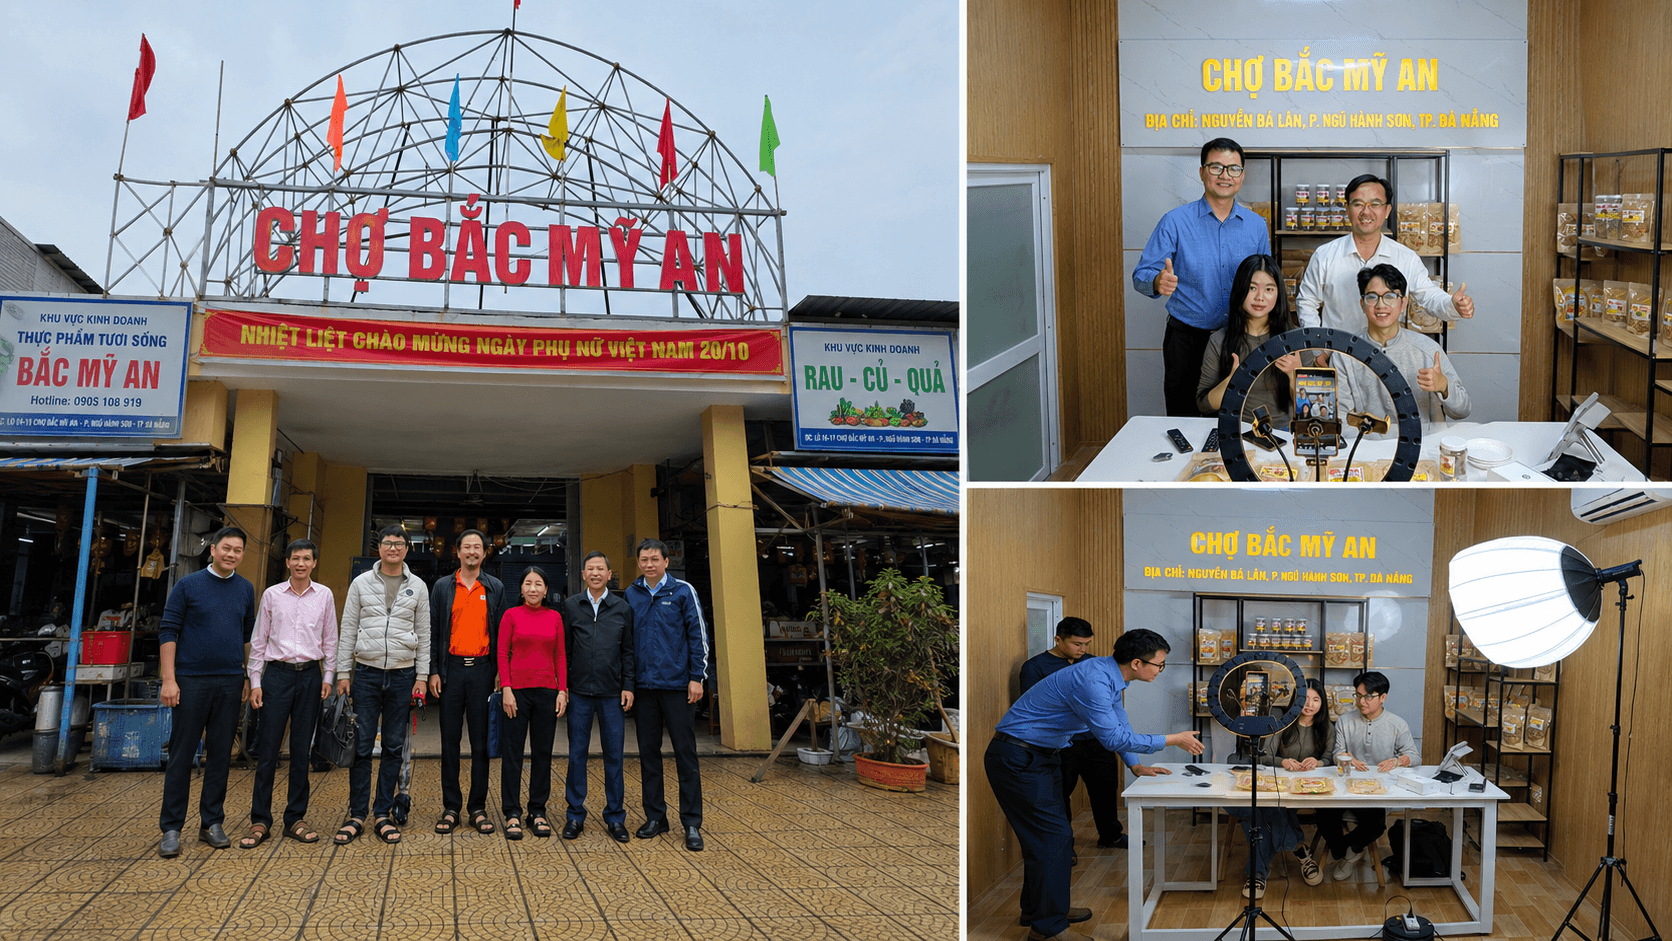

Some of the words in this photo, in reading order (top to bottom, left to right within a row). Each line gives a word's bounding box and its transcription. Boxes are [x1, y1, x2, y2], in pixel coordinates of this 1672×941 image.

[1202, 55, 1264, 98] CHỢ
[1274, 46, 1334, 92] BẮC
[1343, 52, 1388, 92] MỸ
[1397, 58, 1438, 92] AN
[1256, 110, 1274, 128] BÁ
[1277, 111, 1306, 130] LÂN,
[1309, 113, 1320, 128] P.
[1349, 111, 1383, 128] HÀNH
[1419, 113, 1436, 128] TP.
[1439, 110, 1457, 128] ĐÀ
[254, 206, 389, 293] CHỢ
[408, 193, 531, 285] BẮC
[549, 216, 643, 289] MỸ
[659, 230, 745, 293] AN
[40, 313, 63, 323] KHU
[64, 313, 84, 326] VỰC
[86, 315, 110, 325] KINH
[113, 316, 148, 326] DOANH
[17, 330, 52, 347] THỰC
[55, 328, 94, 346] PHẨM
[98, 332, 130, 347] TƯƠI
[241, 323, 300, 350] NHIỆT
[306, 326, 348, 352] LIỆT
[353, 329, 406, 351] CHÀO
[412, 331, 470, 354] MỪNG
[476, 334, 527, 356] NGÀY
[532, 339, 571, 361] PHỤ
[576, 337, 604, 357] NỮ
[608, 337, 646, 362] VIỆT
[652, 341, 694, 359] NAM
[700, 340, 750, 361] 20/10
[824, 343, 843, 352] KHU
[845, 344, 863, 354] VỰC
[865, 344, 887, 353] KINH
[889, 345, 920, 354] DOANH
[16, 346, 69, 387] BẮC
[77, 353, 118, 388] MỸ
[123, 360, 160, 389] AN
[804, 365, 843, 391] RAU
[863, 358, 888, 392] CỦ
[907, 360, 946, 396] QUẢ
[30, 395, 71, 406] Hotline:
[102, 397, 120, 407] 108
[123, 398, 142, 407] 919
[1190, 530, 1240, 560] CHỢ
[1247, 525, 1292, 557] BẮC
[1299, 531, 1336, 558] MỸ
[1342, 536, 1376, 559] AN
[1230, 567, 1244, 580] BÁ
[1271, 571, 1280, 581] P.
[1354, 572, 1368, 583] TP.
